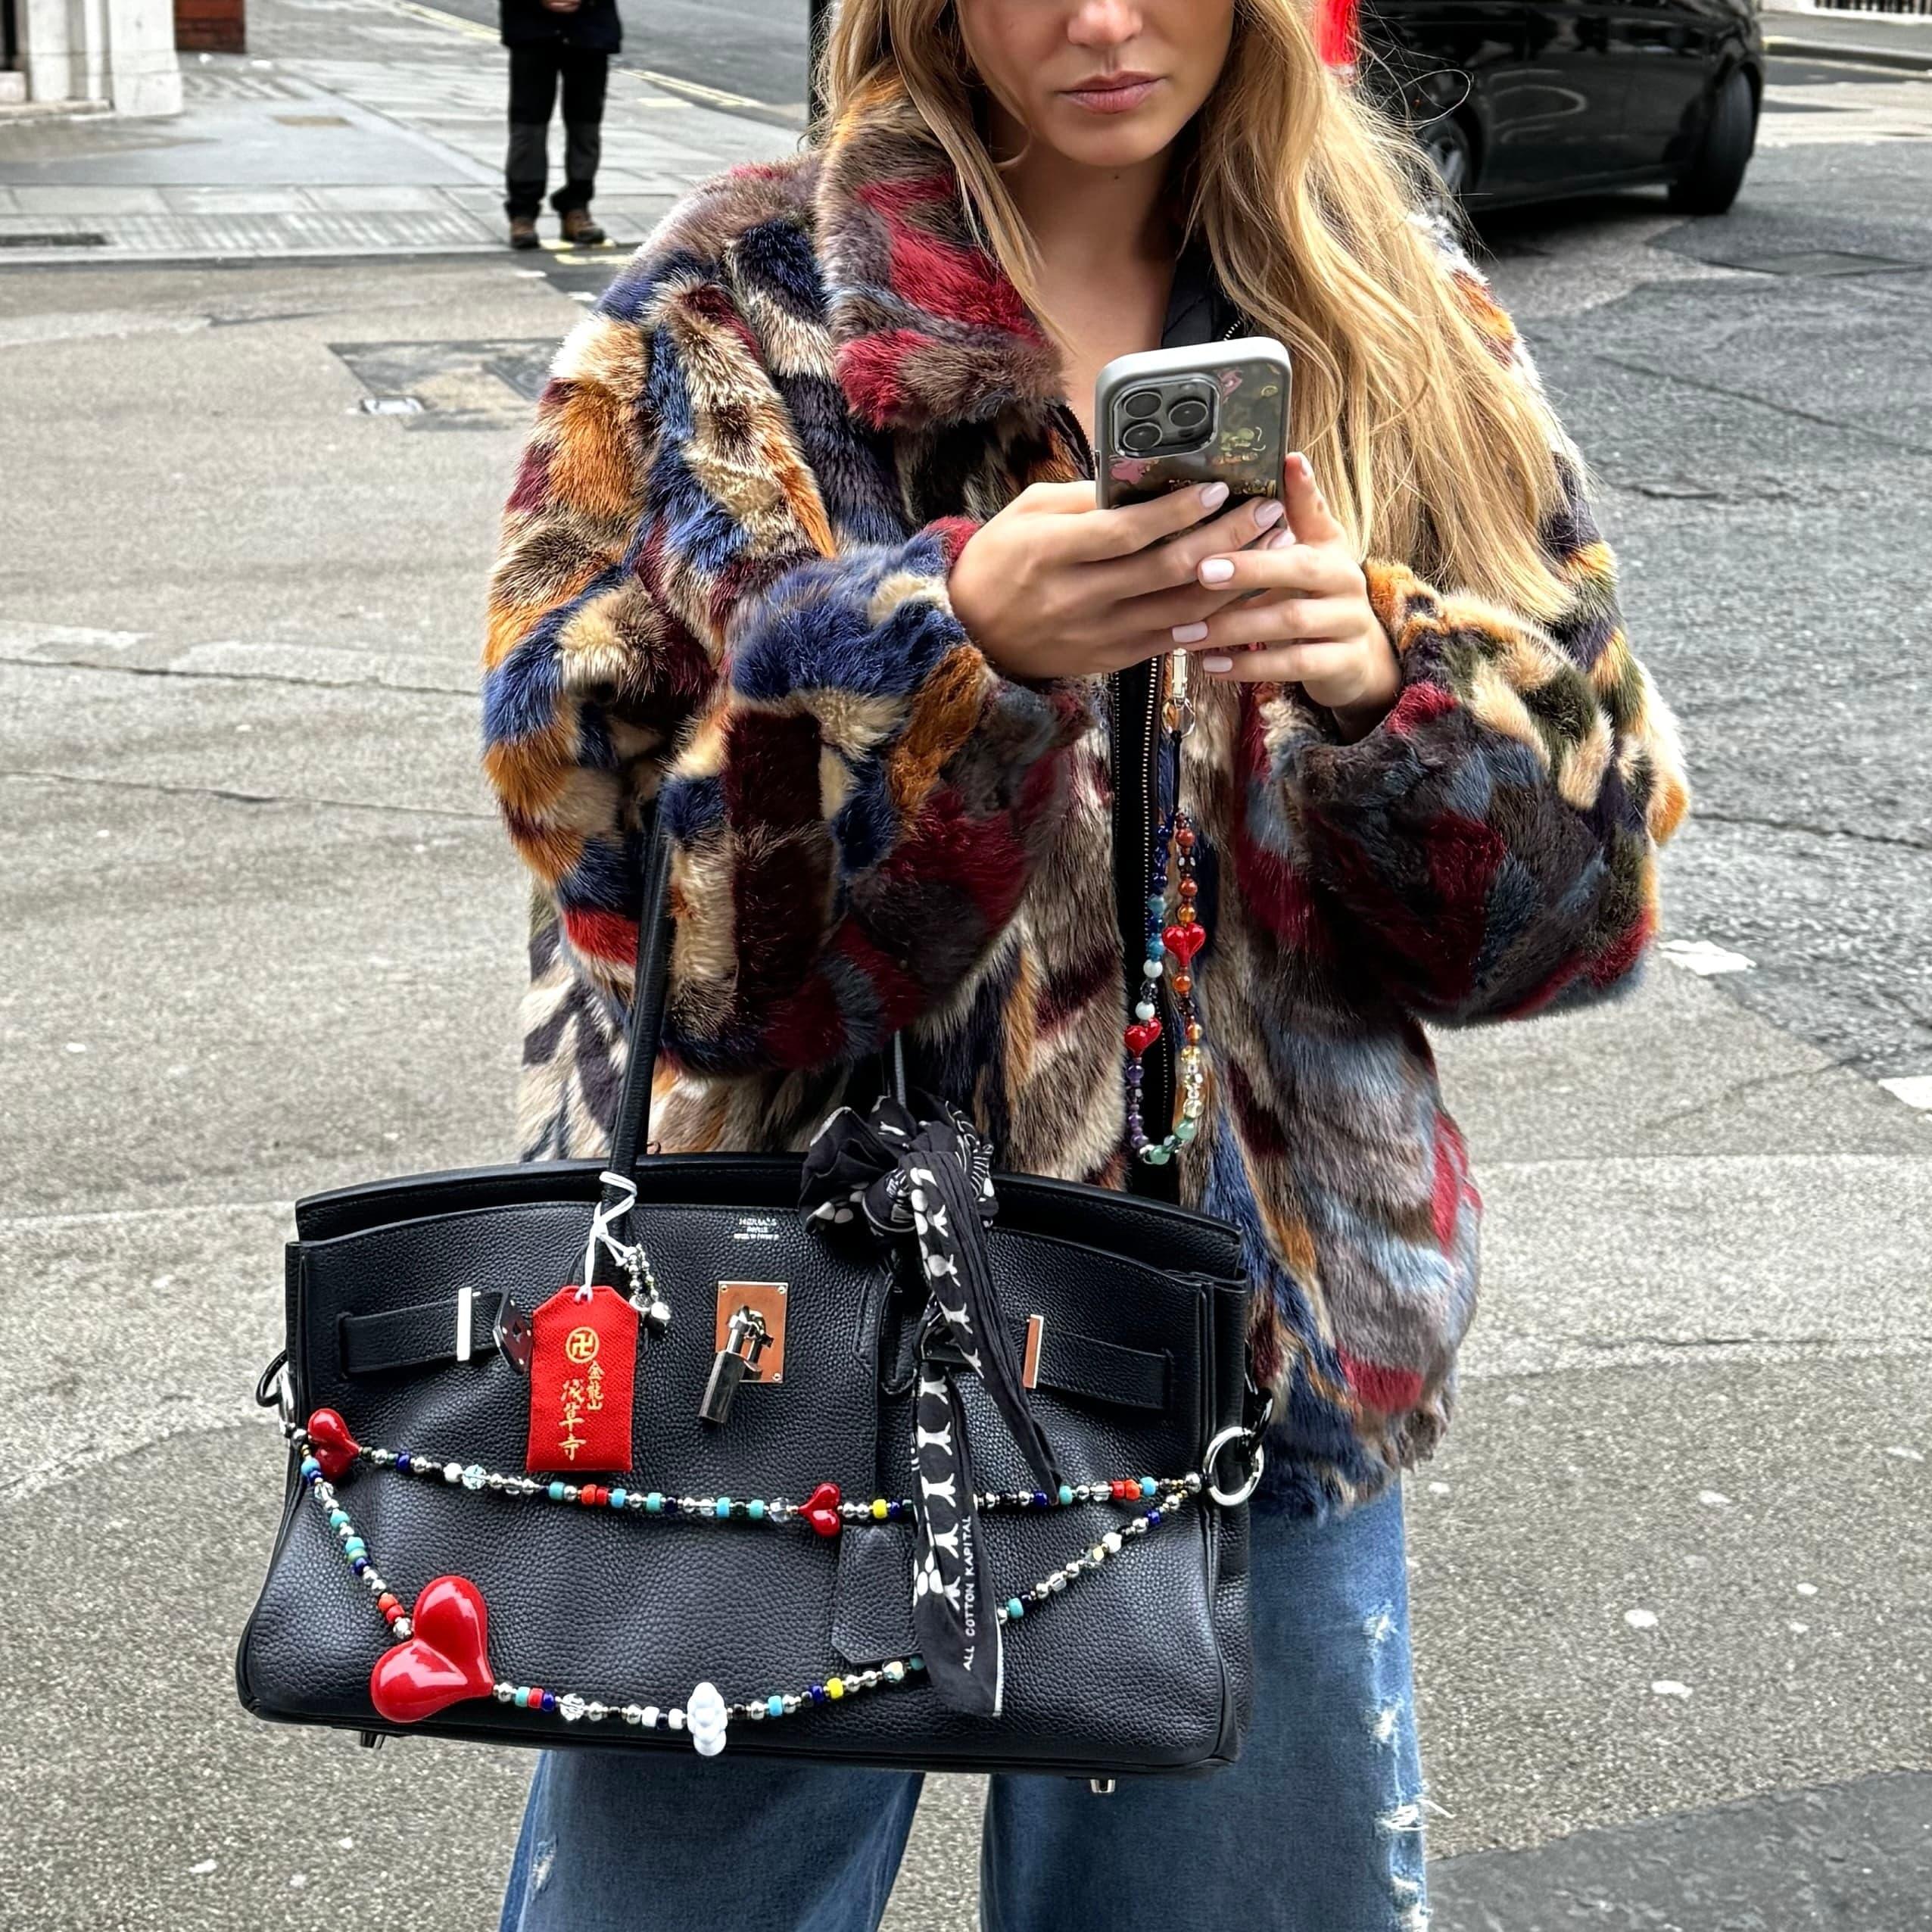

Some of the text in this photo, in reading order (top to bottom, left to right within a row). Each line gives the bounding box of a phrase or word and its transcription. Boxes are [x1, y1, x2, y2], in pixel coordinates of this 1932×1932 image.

[962, 1516, 976, 1672] ALL COTTON KAPITAL
